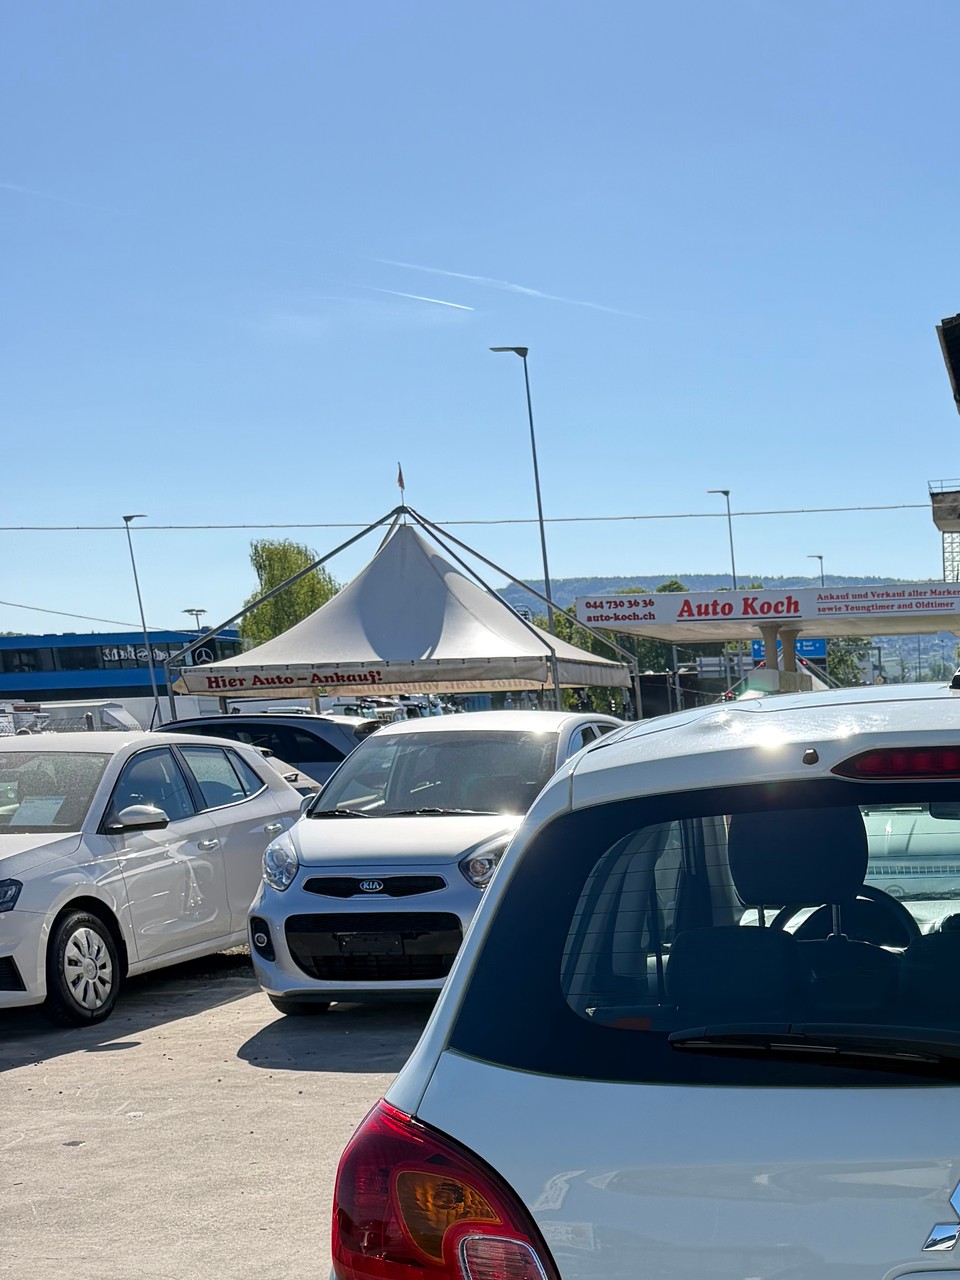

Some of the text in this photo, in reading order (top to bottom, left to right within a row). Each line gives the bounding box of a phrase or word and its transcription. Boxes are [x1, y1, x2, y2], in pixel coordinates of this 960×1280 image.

[817, 593, 849, 601] Ankauf
[851, 592, 869, 600] und
[870, 590, 905, 599] Verkauf
[907, 589, 928, 598] aller
[585, 599, 655, 610] 044 730 36 36
[677, 595, 800, 618] Auto Koch
[817, 604, 841, 613] sowie
[845, 602, 895, 612] Youngtimer
[915, 600, 955, 609] Oldtimer
[586, 612, 655, 623] auto-koch.ch
[206, 675, 246, 689] Hier
[363, 881, 380, 889] KIA
